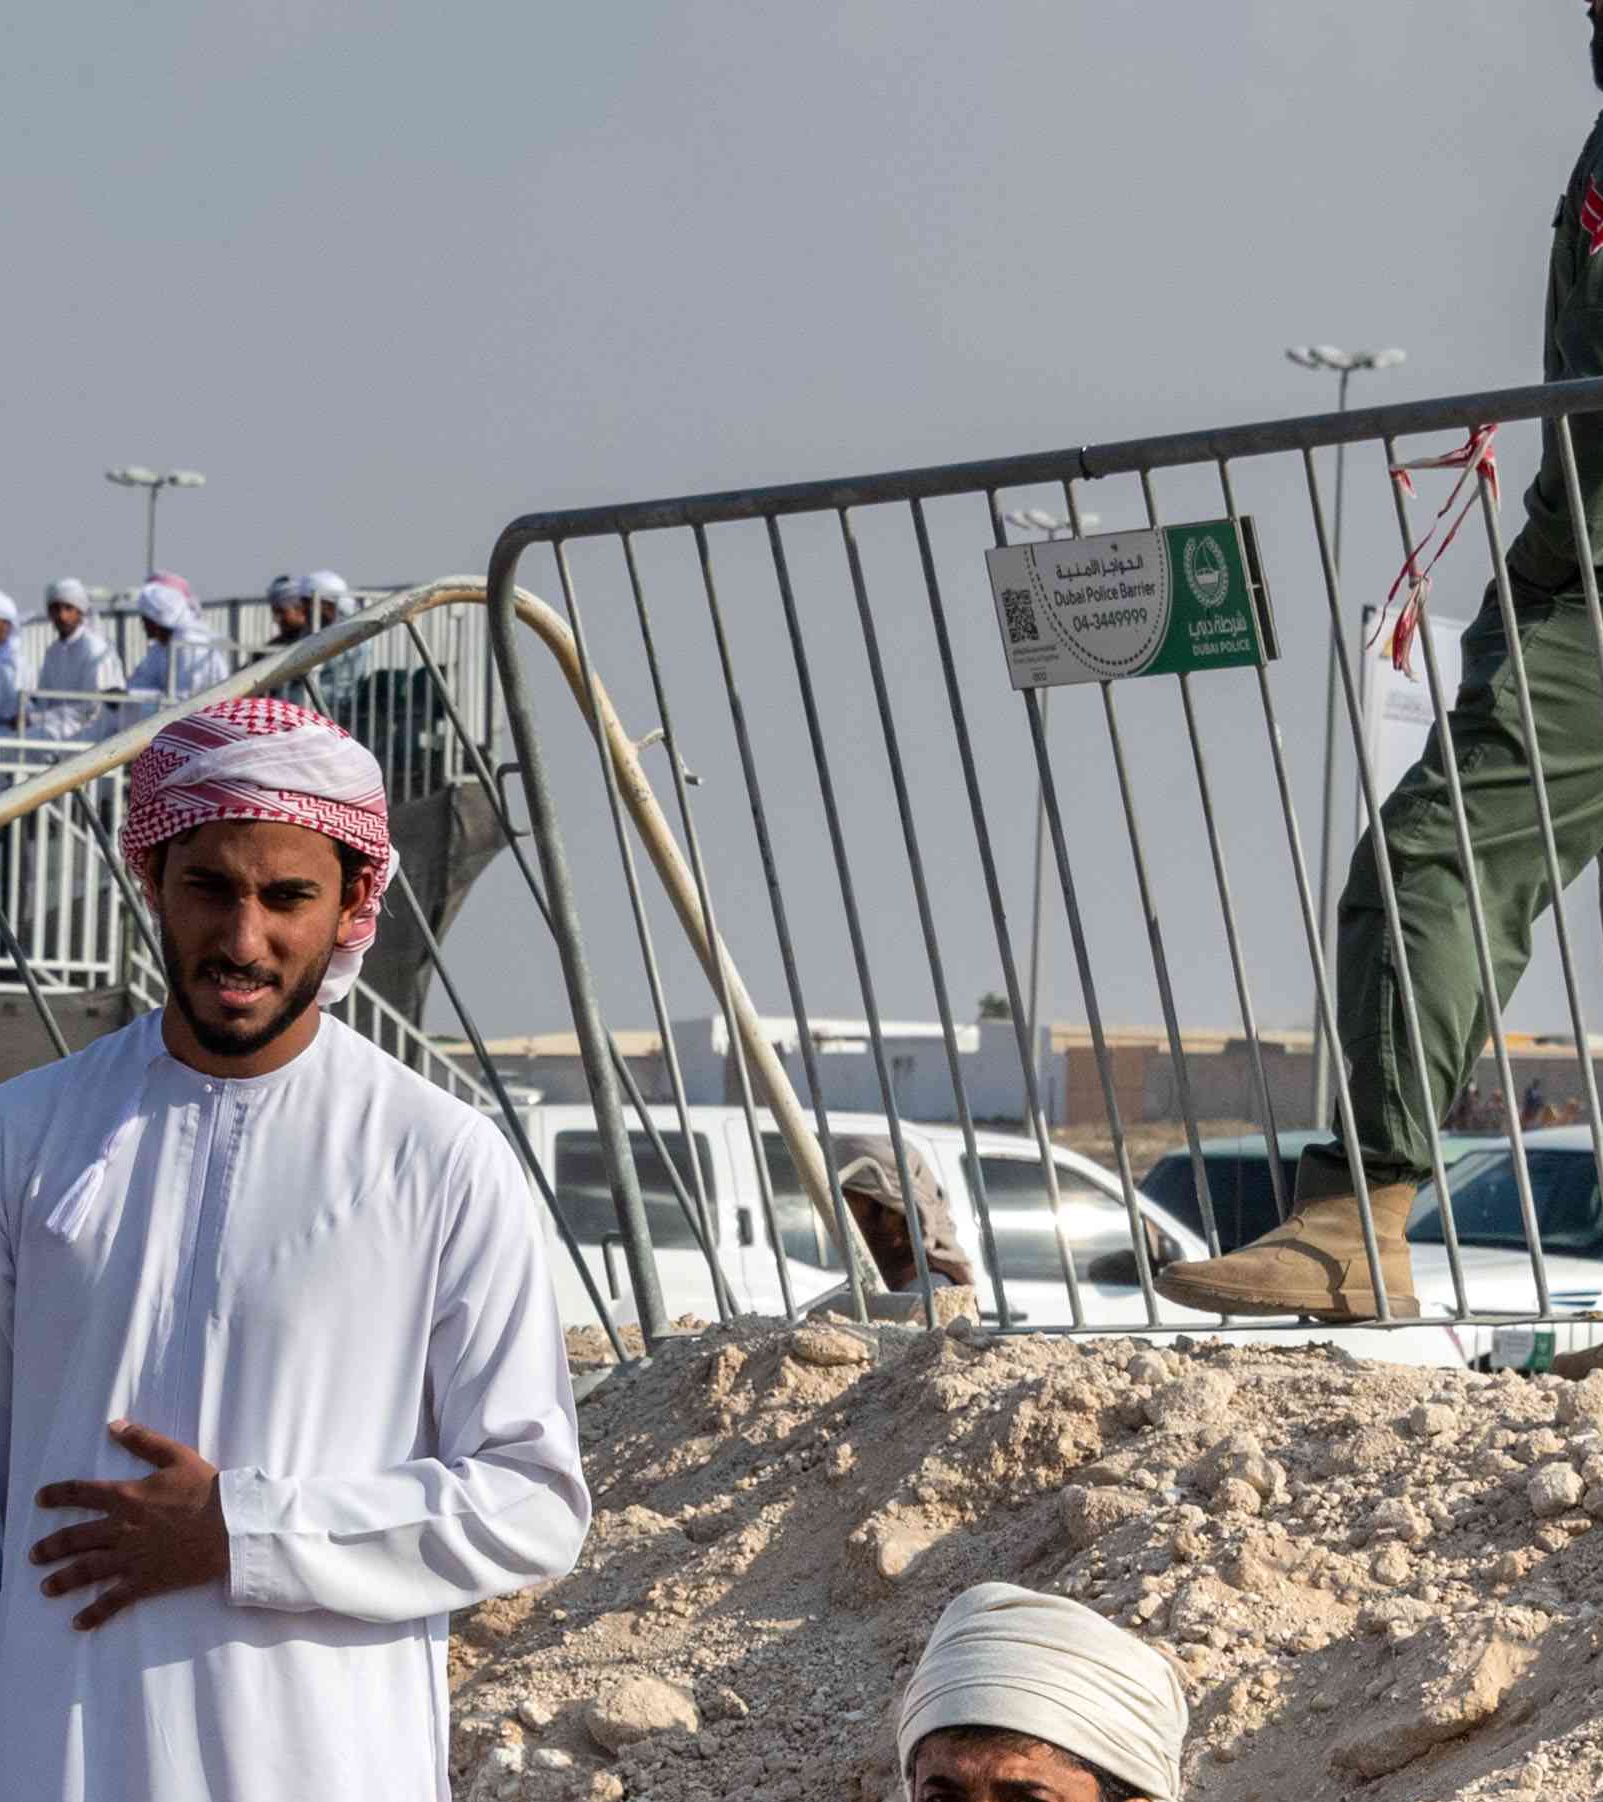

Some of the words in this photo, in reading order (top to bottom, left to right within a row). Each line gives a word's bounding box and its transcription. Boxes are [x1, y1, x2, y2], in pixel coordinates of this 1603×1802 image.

[1054, 587, 1086, 606] Dubai
[1086, 585, 1118, 602] Police
[1119, 581, 1155, 599] Barrier
[1072, 608, 1148, 632] 04-3449999
[1214, 609, 1246, 637] شرطة
[1192, 642, 1219, 656] DUBAI
[1220, 638, 1251, 653] POLICE
